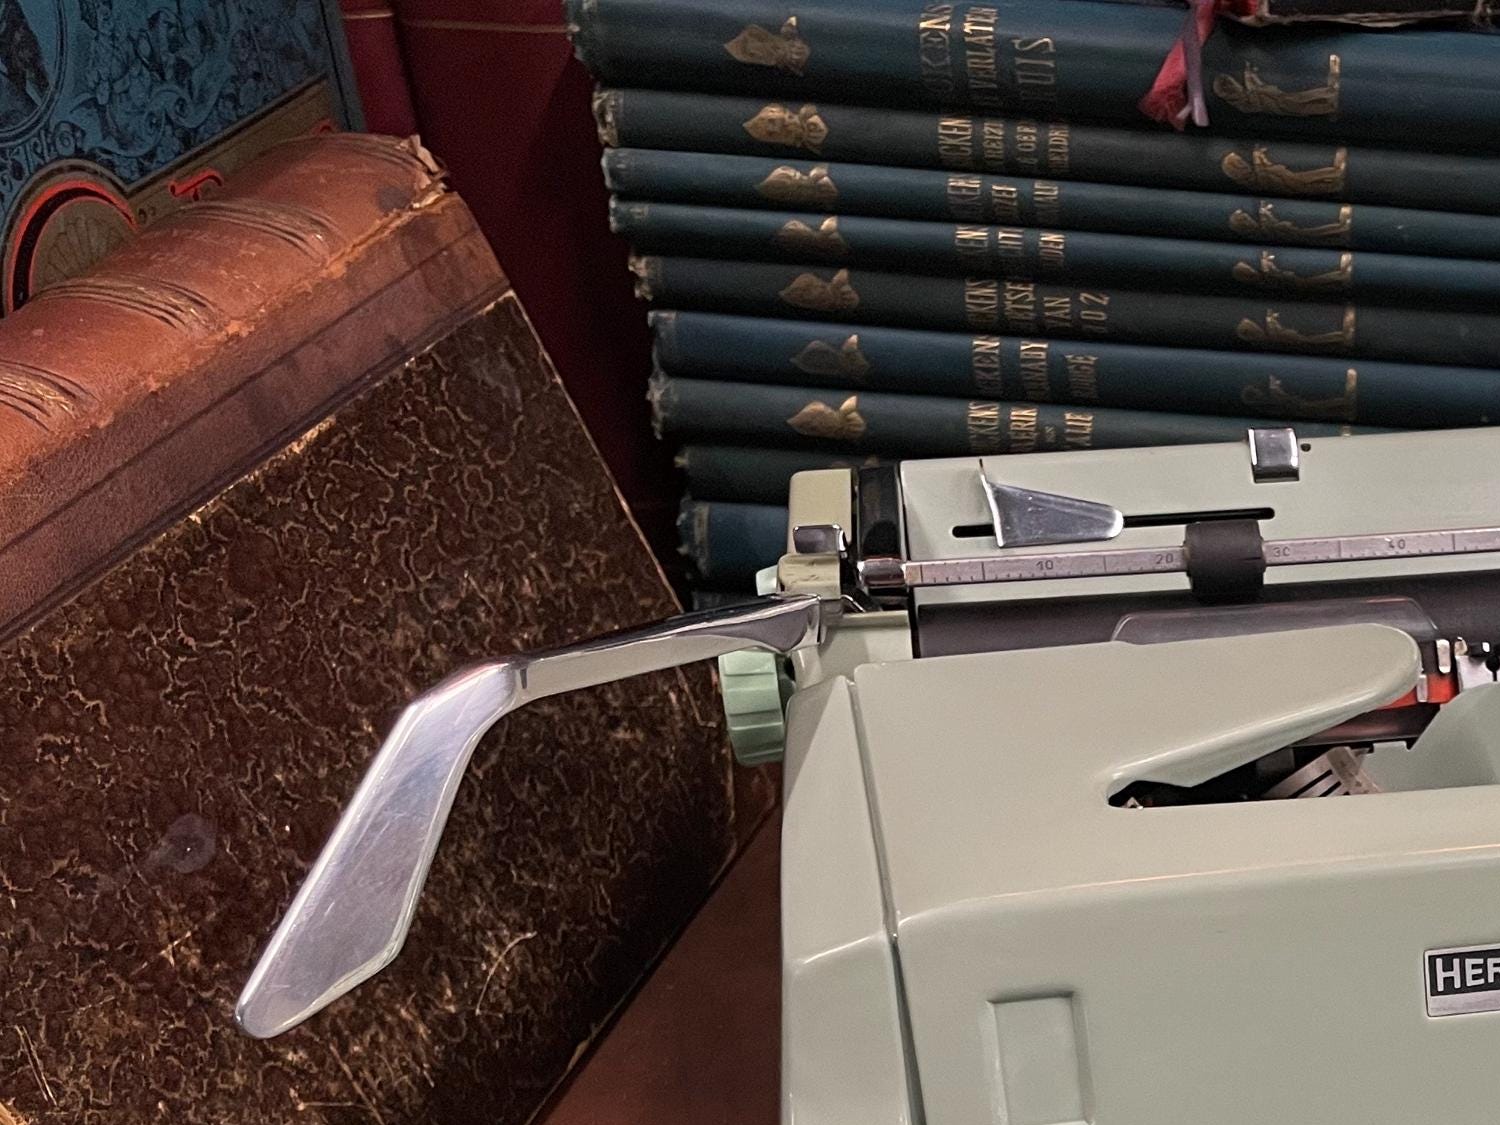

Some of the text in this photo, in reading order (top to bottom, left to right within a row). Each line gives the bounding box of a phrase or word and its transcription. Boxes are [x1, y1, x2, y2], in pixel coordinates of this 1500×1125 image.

[1035, 559, 1054, 572] 10
[1155, 552, 1174, 565] 20
[1272, 546, 1291, 559] 30
